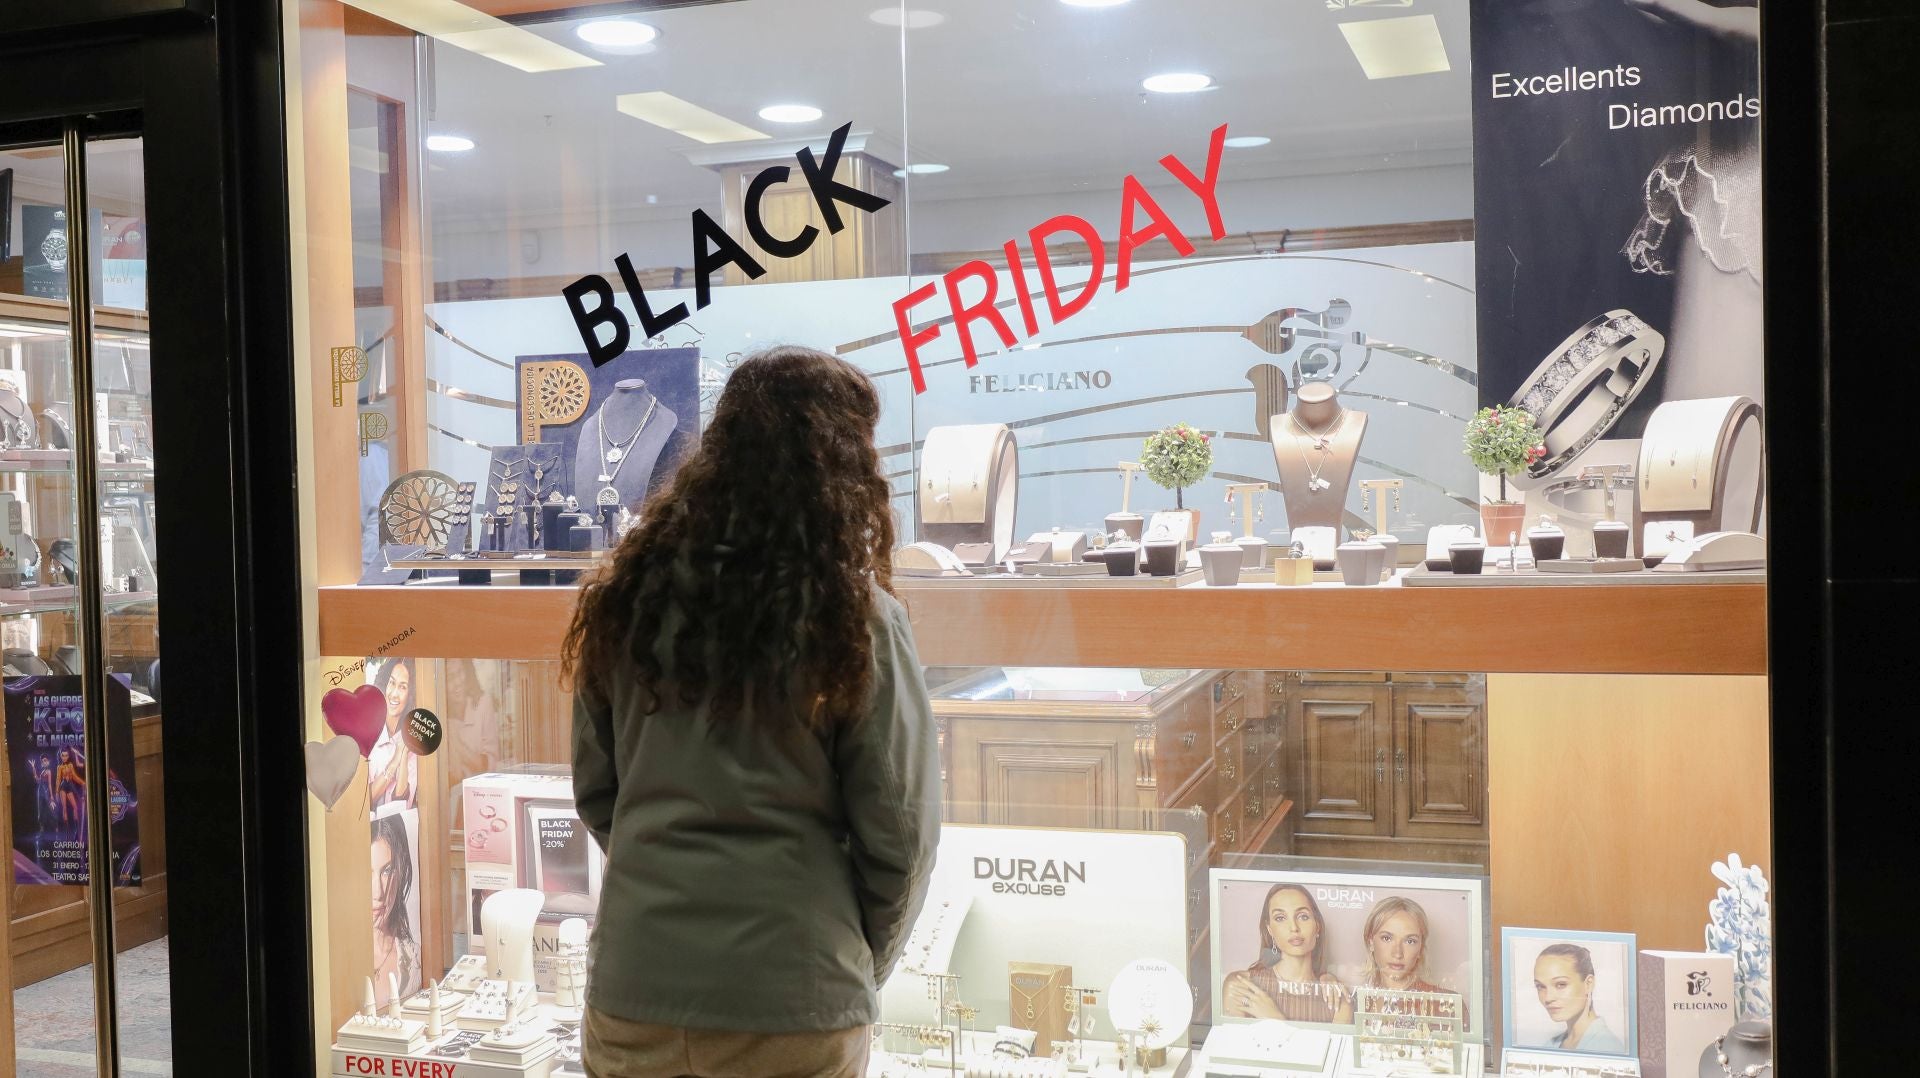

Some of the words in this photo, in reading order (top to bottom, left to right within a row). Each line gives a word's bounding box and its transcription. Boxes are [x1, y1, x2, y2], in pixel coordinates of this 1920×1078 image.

[1492, 64, 1641, 98] Excellents
[1608, 93, 1760, 130] Diamonds
[562, 120, 892, 368] BLACK
[892, 123, 1228, 395] FRIDAY
[968, 370, 1112, 394] FELICIANO
[526, 367, 535, 420] DESCONOCIDA
[377, 626, 416, 654] PANDORA
[34, 695, 50, 706] LAS
[51, 695, 83, 707] GUERRE
[33, 707, 84, 732] K-PO
[410, 719, 436, 739] FRIDAY
[414, 711, 437, 730] BLACK
[36, 734, 49, 747] EL
[51, 734, 85, 747] MUSIC
[541, 820, 572, 828] BLACK
[541, 830, 574, 838] FRIDAY
[36, 850, 50, 858] LOS
[52, 873, 76, 881] TEATRO
[973, 856, 1086, 884] DURAN
[1316, 887, 1374, 903] DURAN
[1278, 980, 1344, 998] PRETTY
[1673, 1002, 1728, 1010] FELICIANO
[345, 1055, 386, 1075] FOR
[391, 1058, 456, 1078] EVERY
